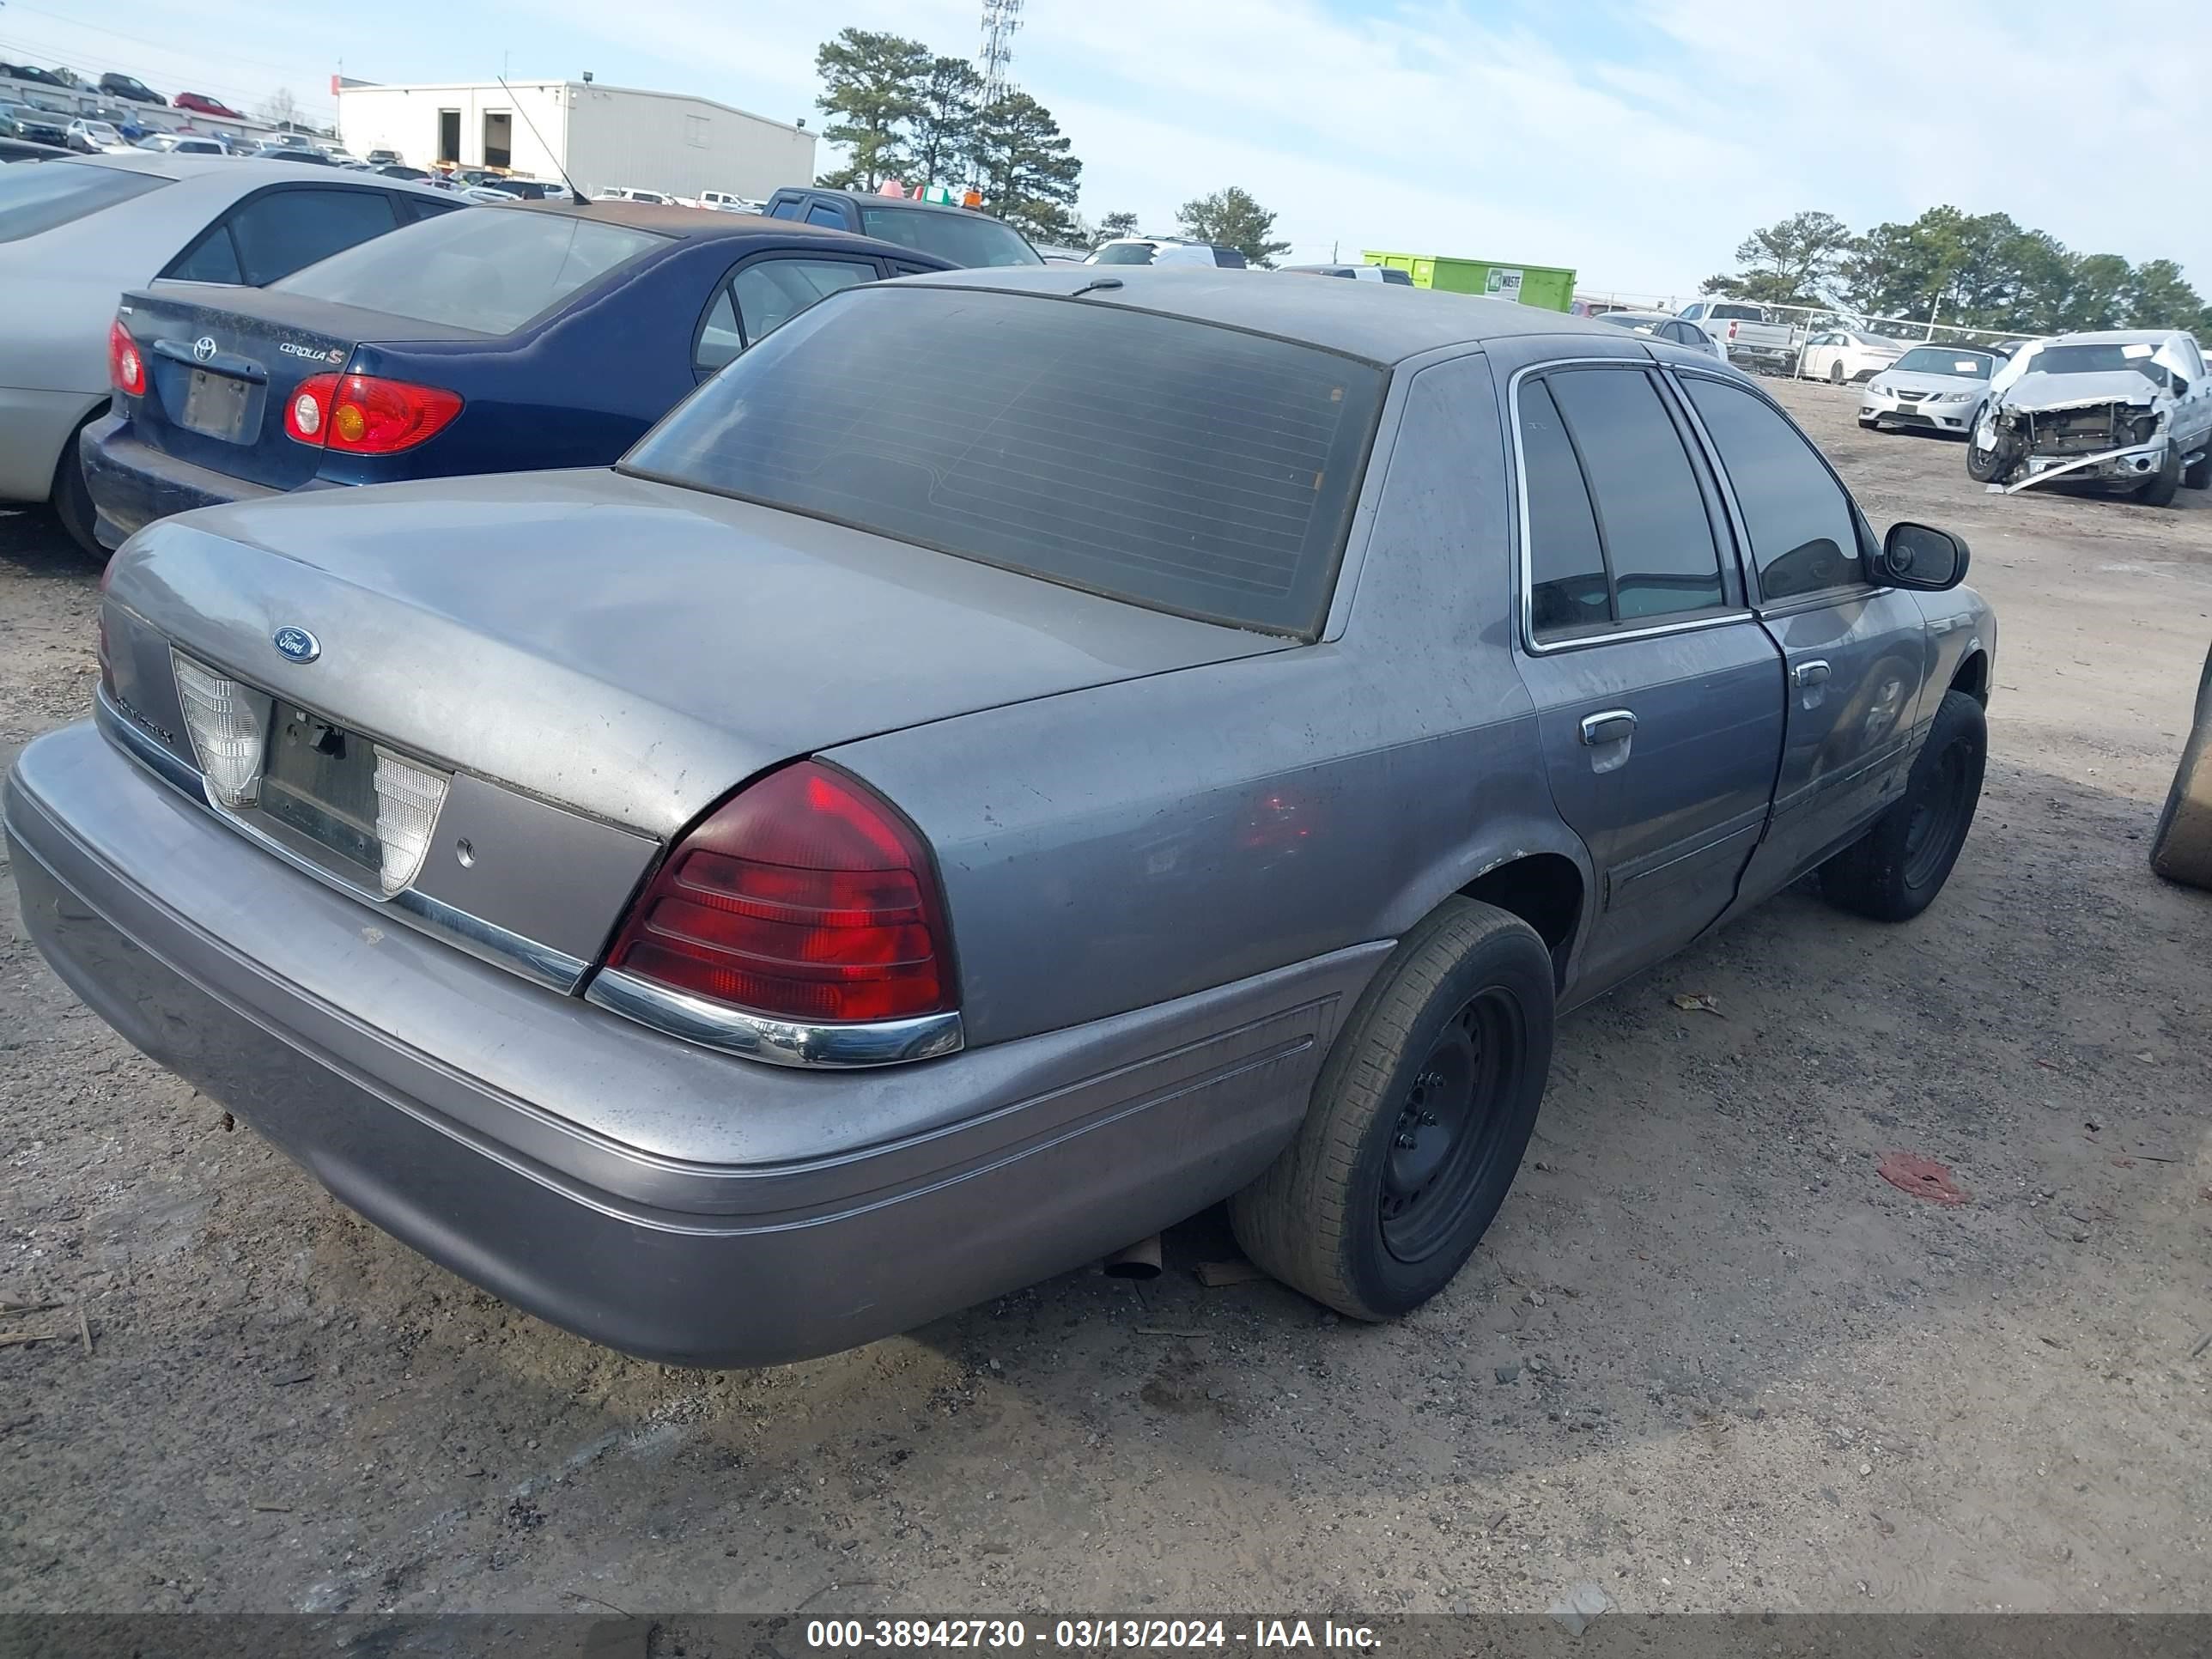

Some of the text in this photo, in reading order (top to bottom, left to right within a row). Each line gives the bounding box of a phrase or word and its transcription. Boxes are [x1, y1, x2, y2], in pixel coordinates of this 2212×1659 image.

[1501, 275, 1521, 289] WASTE
[280, 343, 344, 364] COROLLA S
[279, 631, 306, 654] Ford
